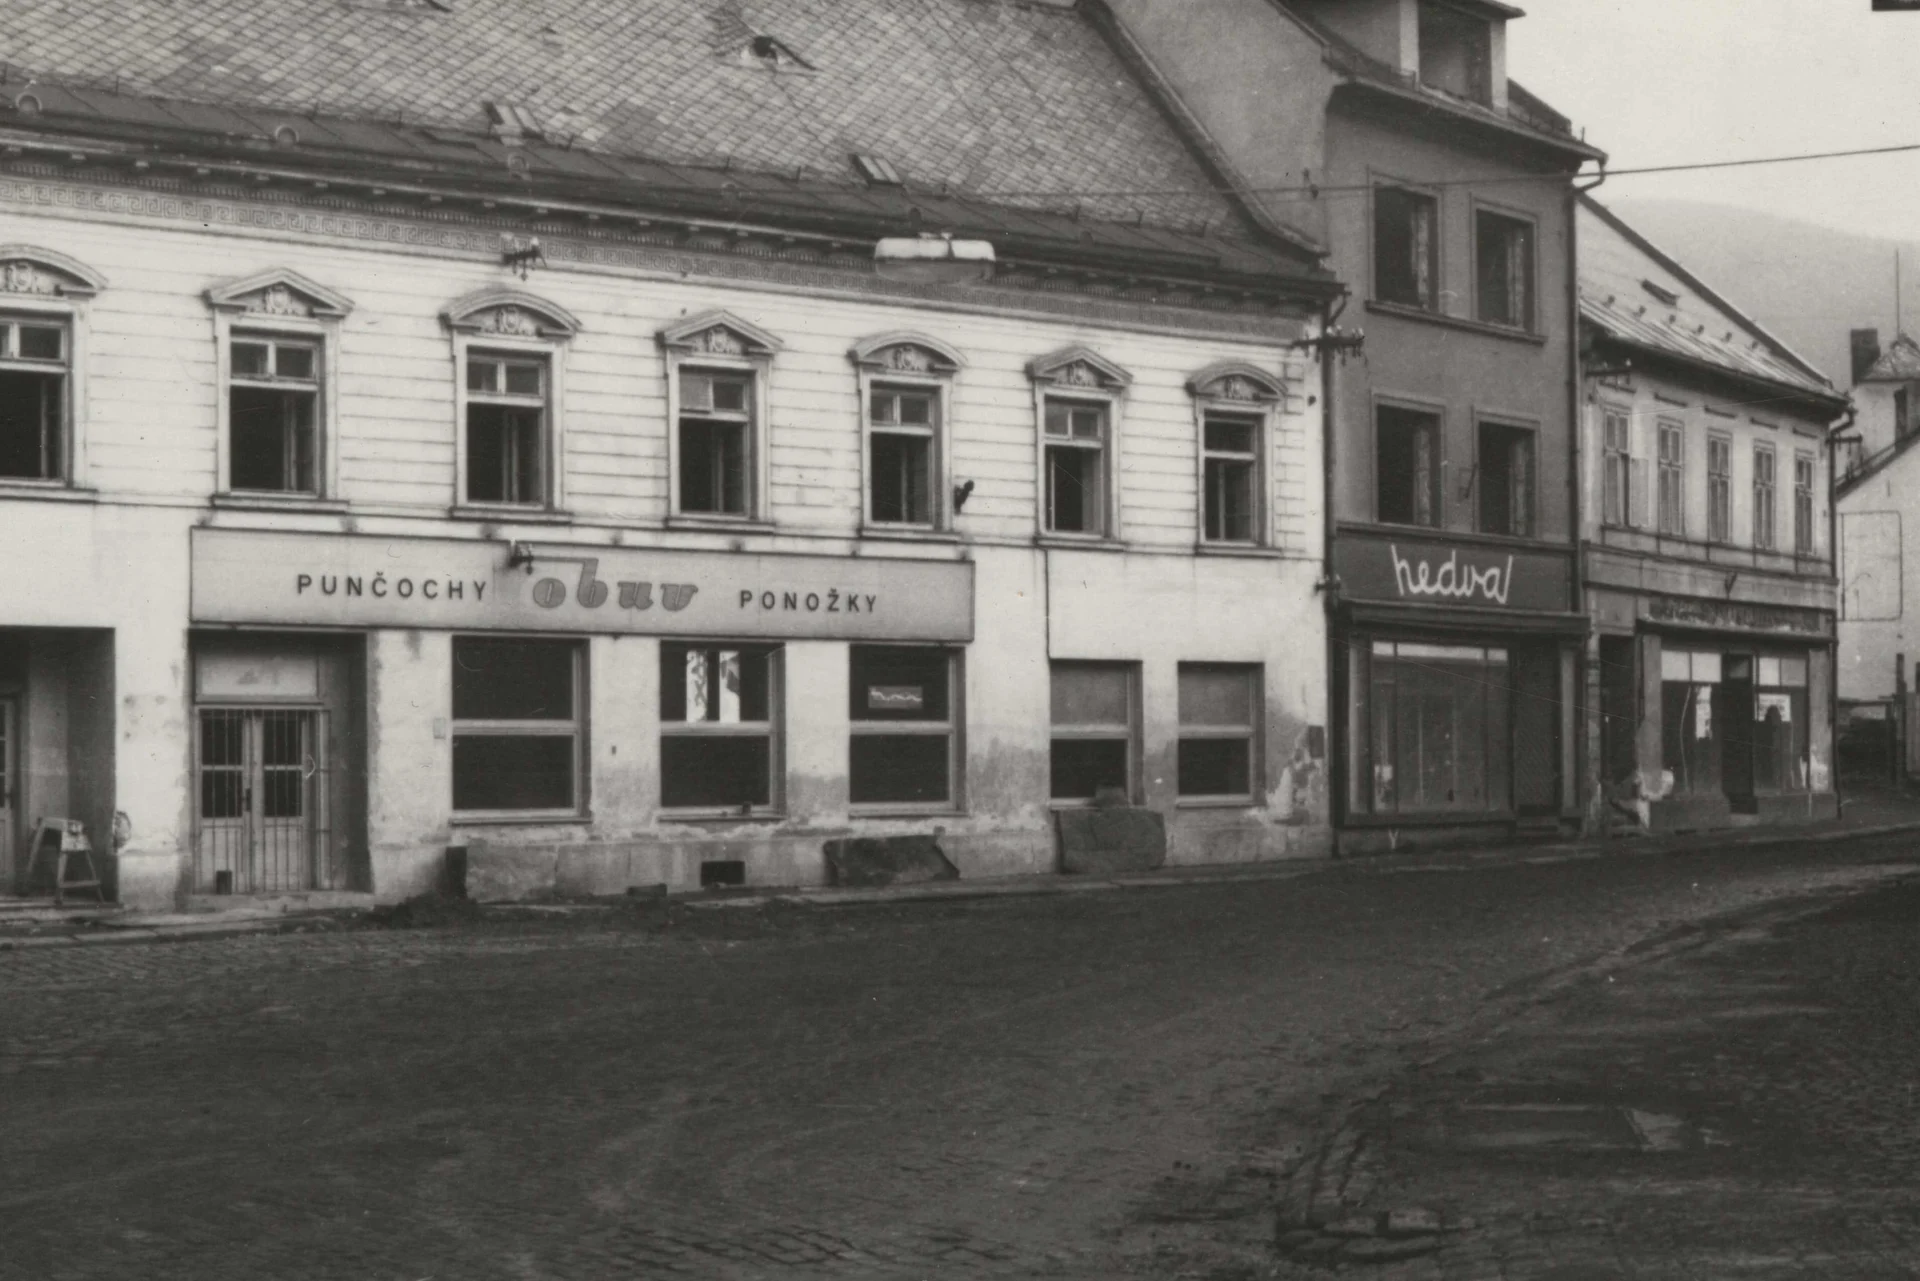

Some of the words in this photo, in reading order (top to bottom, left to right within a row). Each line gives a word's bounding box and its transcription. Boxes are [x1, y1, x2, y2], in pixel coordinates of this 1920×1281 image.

[297, 571, 486, 600] PUNČOCHY
[532, 557, 699, 612] obuv
[739, 587, 876, 613] PONOŽKY
